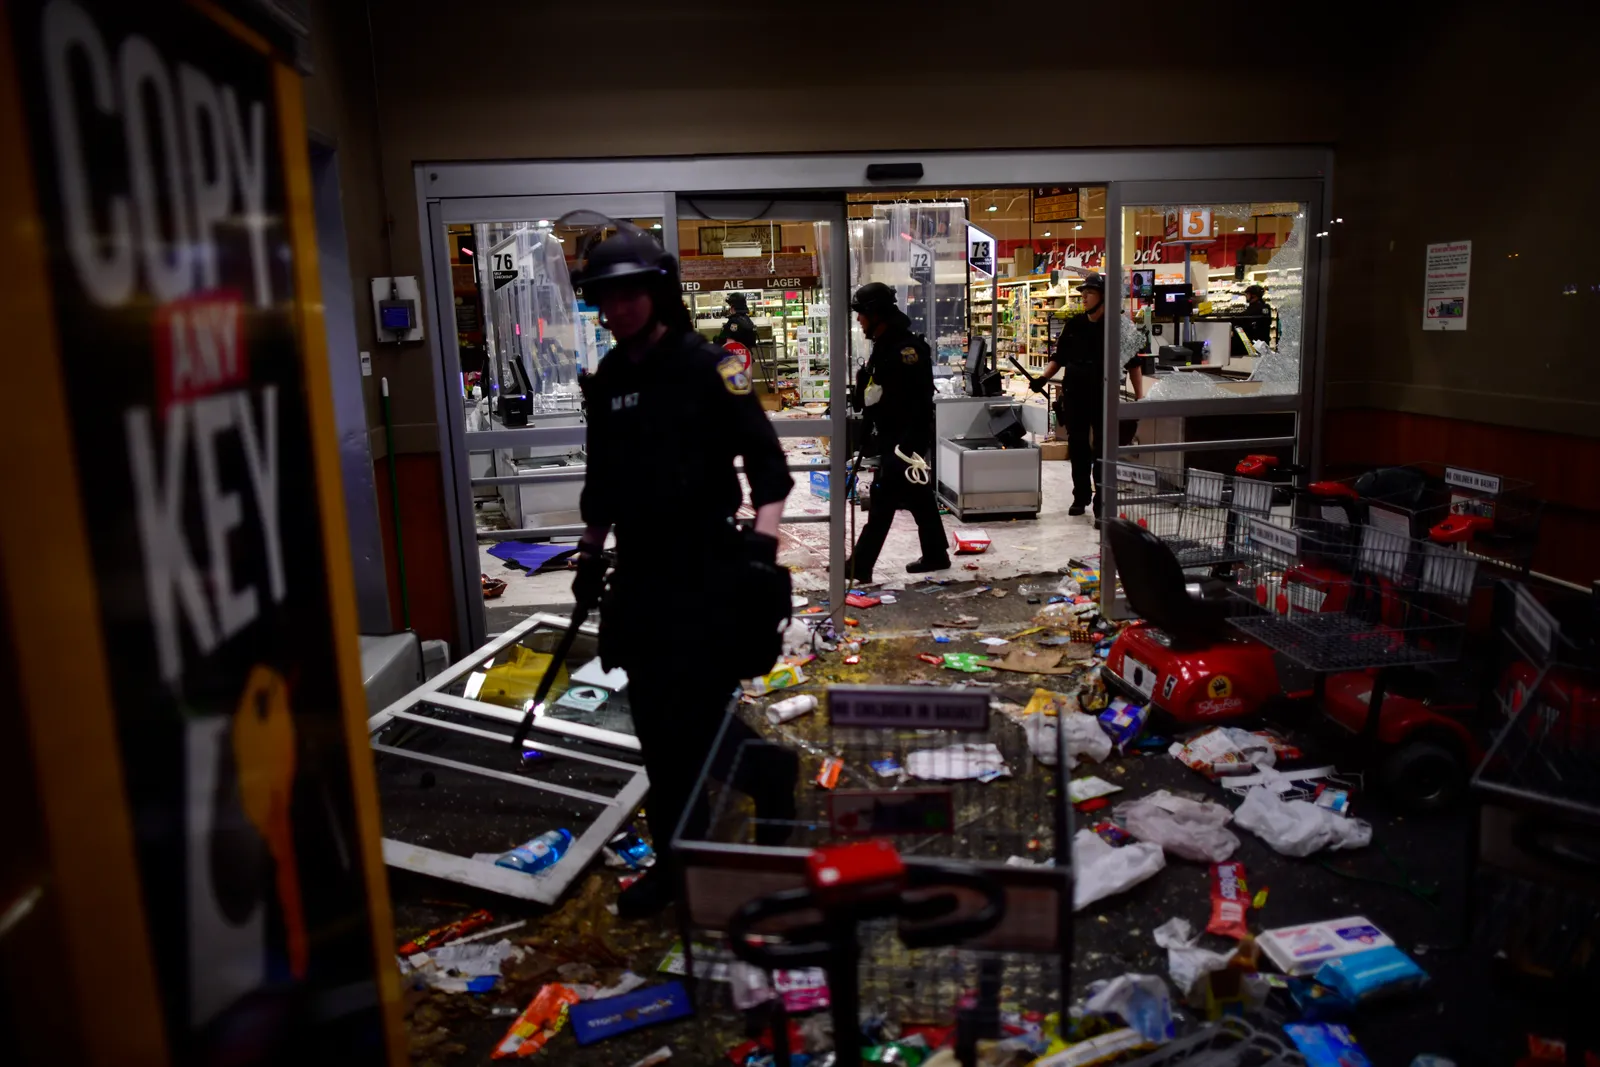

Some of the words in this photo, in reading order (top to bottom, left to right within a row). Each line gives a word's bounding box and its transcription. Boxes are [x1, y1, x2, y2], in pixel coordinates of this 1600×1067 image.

[41, 0, 274, 309] COPY
[1187, 211, 1205, 235] 5
[972, 241, 990, 257] 73
[1133, 240, 1161, 263] ock
[494, 253, 513, 271] 76
[913, 253, 928, 267] 72
[723, 280, 744, 290] ALE
[766, 278, 801, 288] LAGER
[168, 301, 240, 399] ANY
[1446, 471, 1452, 480] NO
[1452, 472, 1473, 485] CHILDREN
[1474, 478, 1479, 486] IN
[1480, 479, 1498, 490] BASKET
[122, 383, 288, 685] KEY
[1164, 675, 1175, 697] 5
